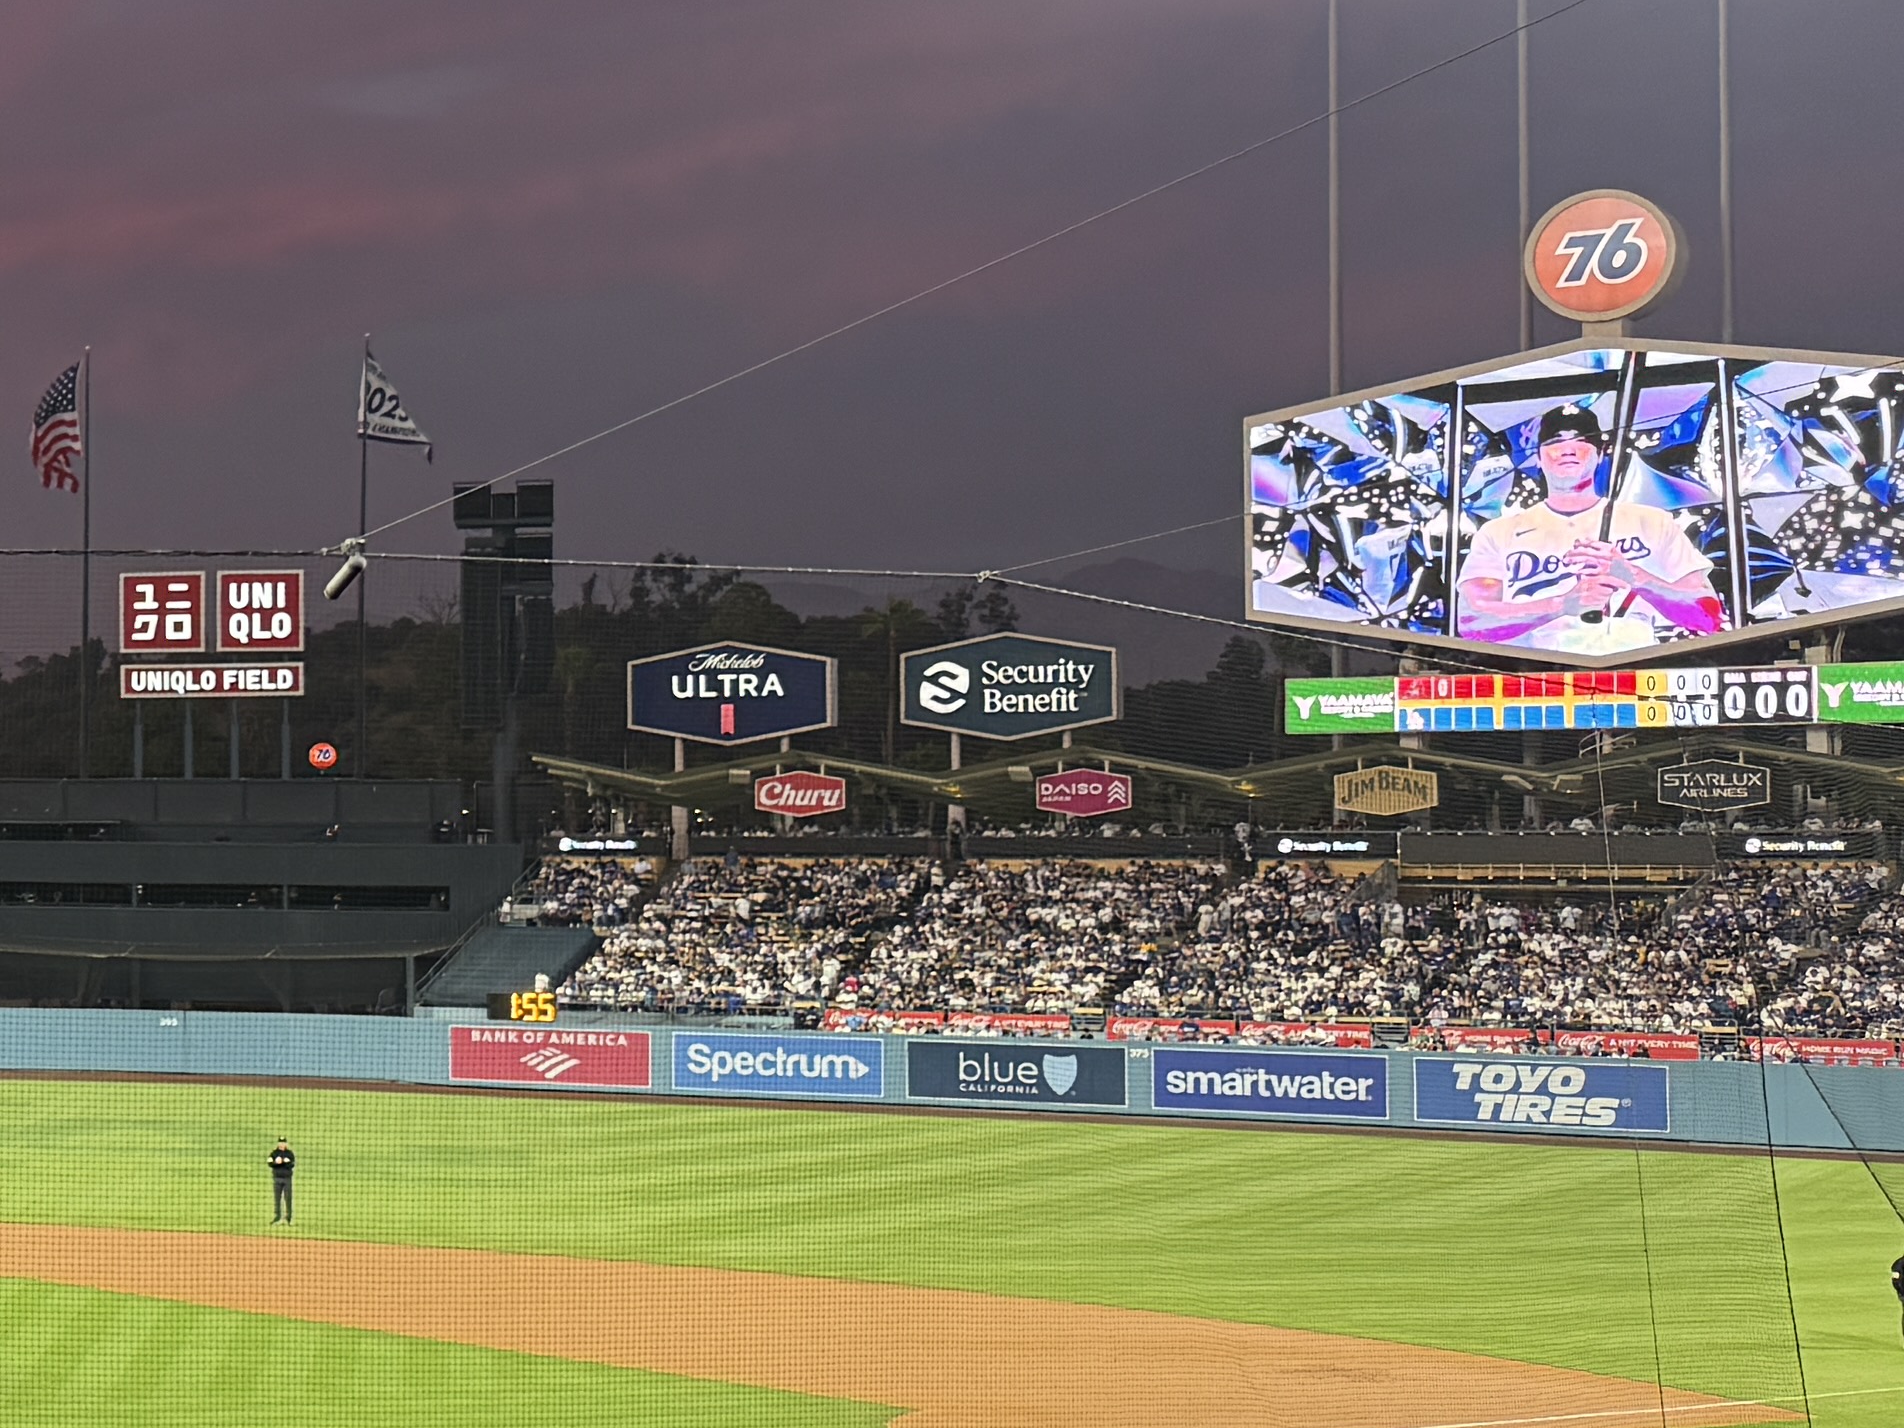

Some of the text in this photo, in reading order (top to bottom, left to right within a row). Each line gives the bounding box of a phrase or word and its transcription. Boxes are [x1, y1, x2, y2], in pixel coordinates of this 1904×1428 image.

[1555, 217, 1649, 287] 76
[1506, 536, 1651, 587] Dors
[132, 583, 192, 610] ユニ
[229, 581, 286, 608] UNI
[131, 613, 191, 640] クロ
[229, 612, 292, 644] QLO
[688, 653, 765, 672] Michelob
[981, 659, 1094, 688] Security
[130, 669, 293, 694] UNIQLO FIELD
[671, 674, 785, 699] ULTRA
[983, 688, 1080, 713] Benefit
[1723, 684, 1808, 718] 0 0 0
[1041, 783, 1103, 796] DAISO
[1341, 772, 1429, 805] JIM BEAM
[1663, 772, 1763, 787] STARLUX
[1679, 787, 1748, 798] AIRLINES
[759, 781, 842, 806] Churu
[1762, 840, 1806, 852] Security
[511, 992, 556, 1022] 1:55
[471, 1029, 628, 1047] BANK OF AMERICA
[686, 1043, 860, 1082] Spectrum
[958, 1051, 1039, 1084] blue
[959, 1083, 1039, 1095] CALIFORNIA
[1165, 1070, 1373, 1102] smartwater
[1453, 1063, 1587, 1093] TOYO
[1473, 1095, 1620, 1126] TIRES
